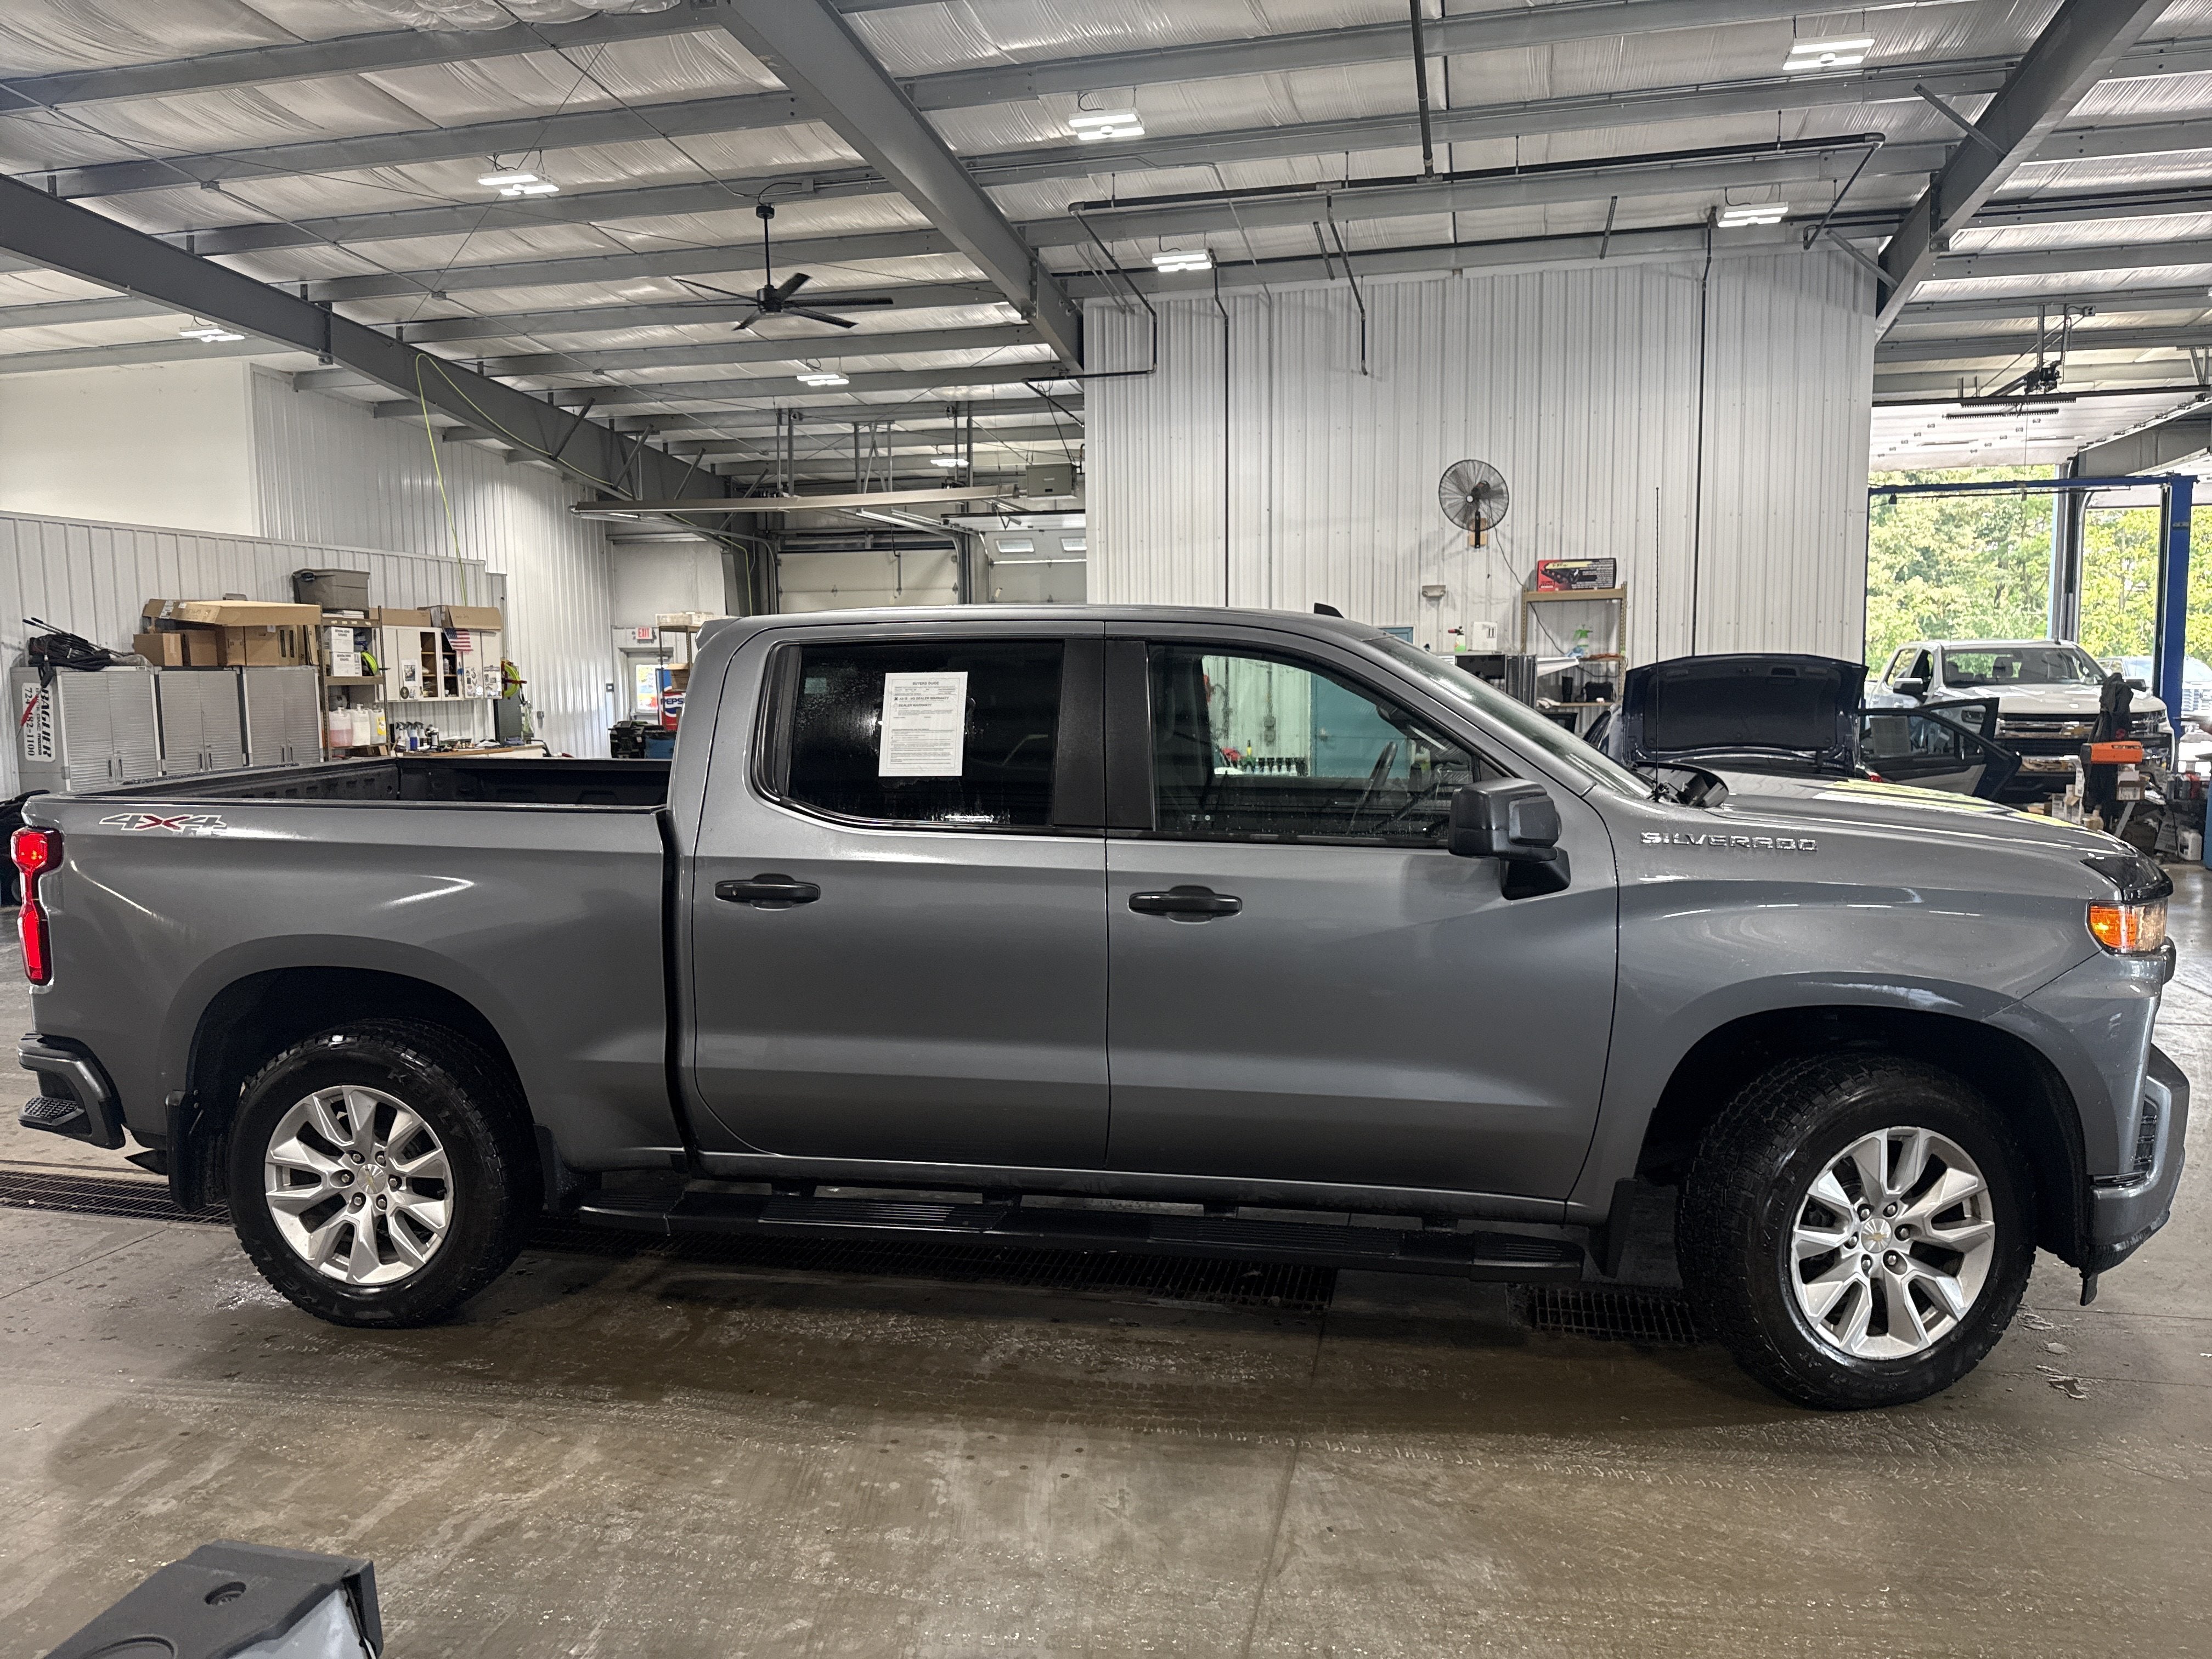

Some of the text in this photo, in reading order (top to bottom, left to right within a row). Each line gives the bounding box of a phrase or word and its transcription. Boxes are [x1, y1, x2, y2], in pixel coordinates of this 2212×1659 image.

[638, 628, 650, 637] EXIT
[41, 688, 52, 758] BAGLIER
[1641, 832, 1818, 851] SILVERADO
